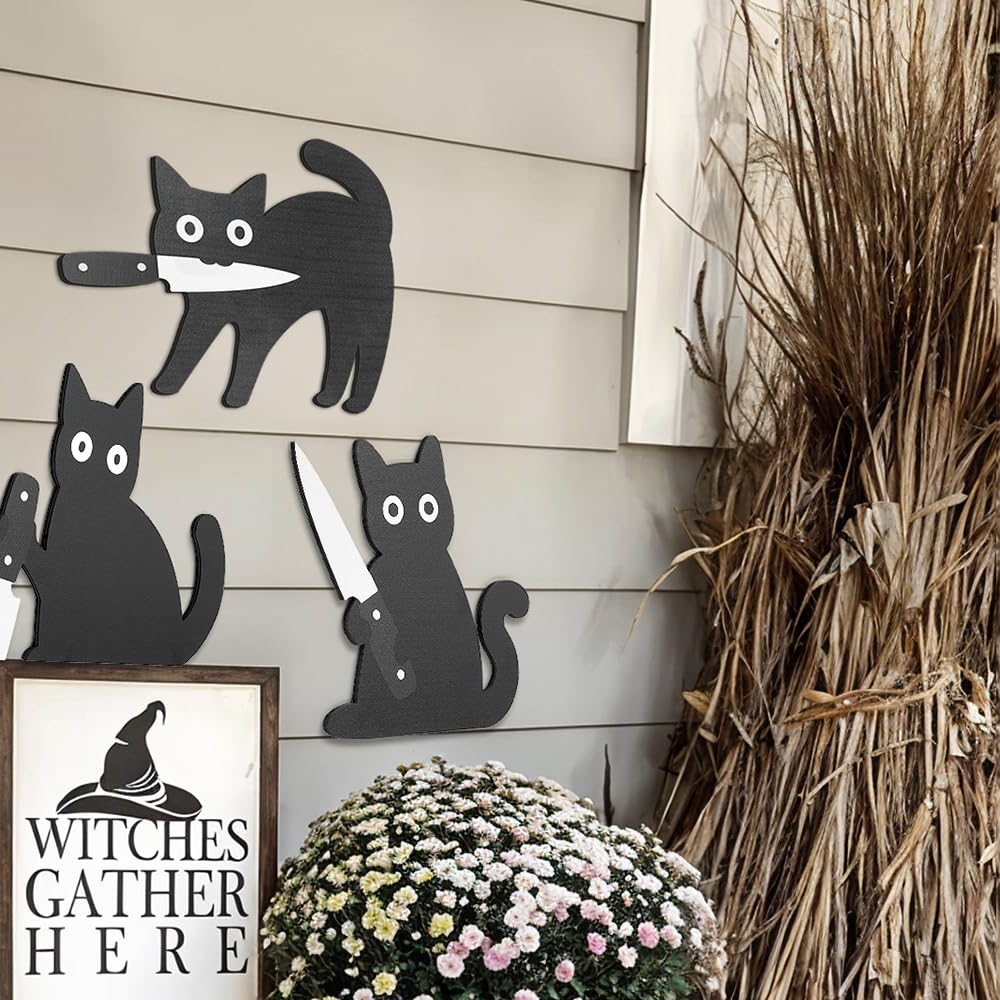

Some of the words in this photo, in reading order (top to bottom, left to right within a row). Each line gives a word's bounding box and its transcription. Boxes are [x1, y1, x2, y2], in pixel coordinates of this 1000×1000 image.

[25, 817, 249, 862] WITCHES
[25, 868, 249, 919] GATHER
[24, 926, 249, 976] HERE
